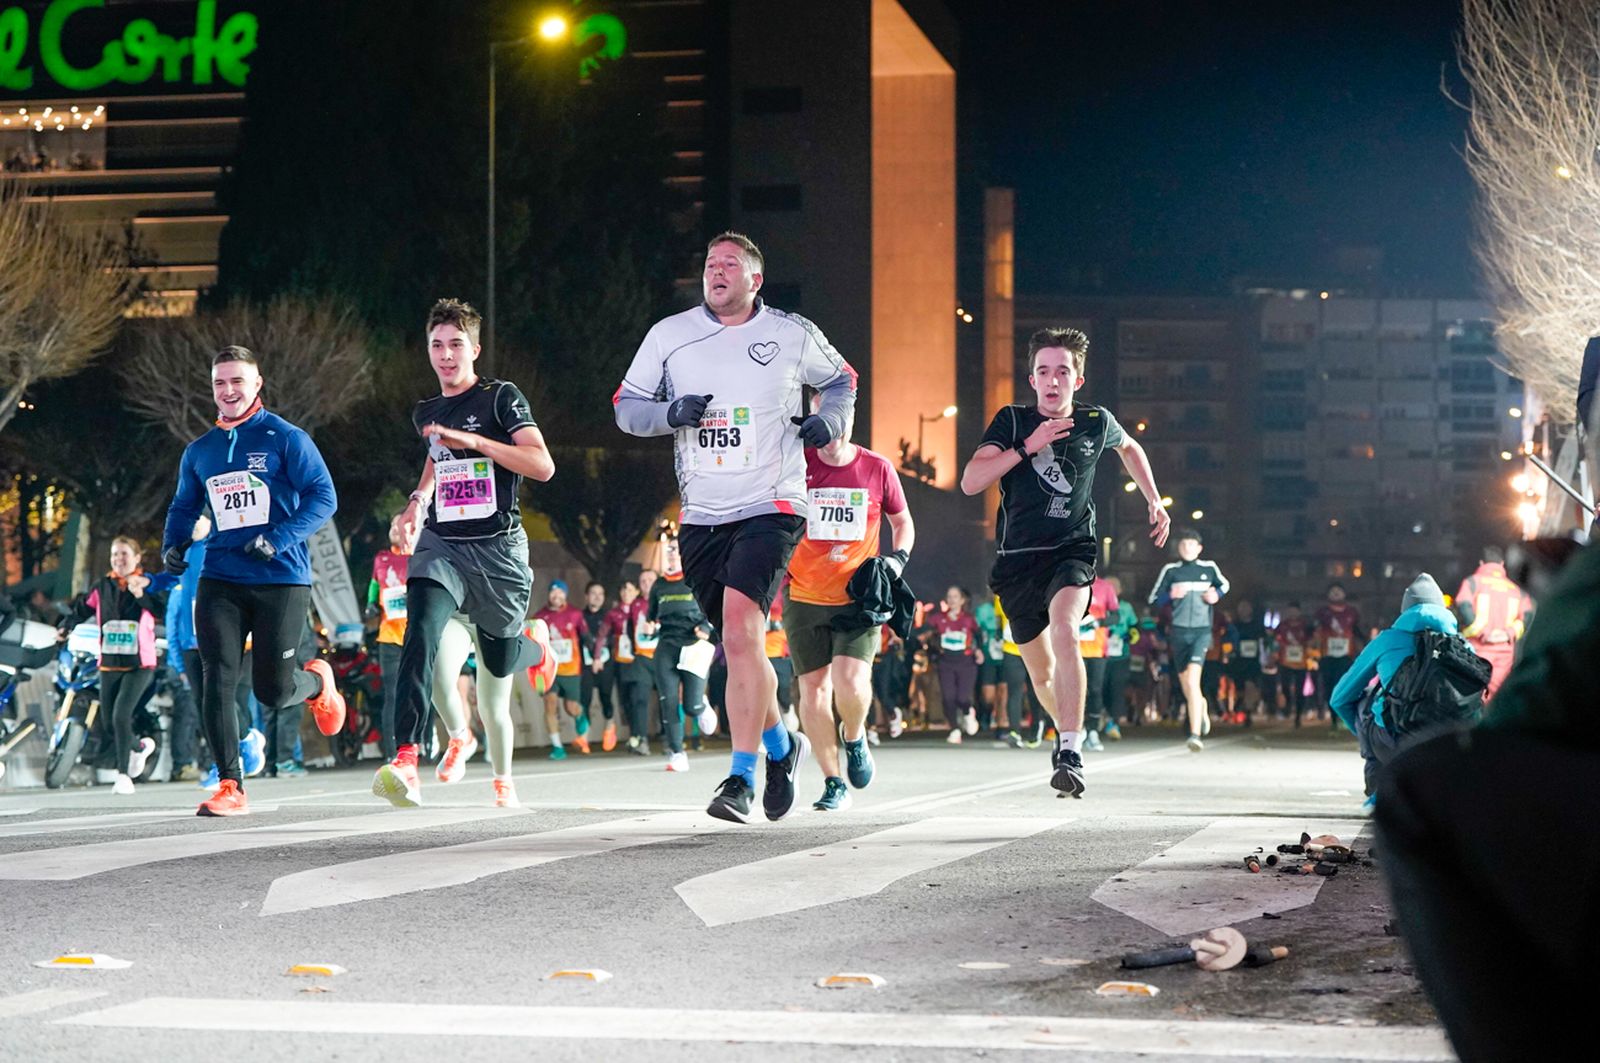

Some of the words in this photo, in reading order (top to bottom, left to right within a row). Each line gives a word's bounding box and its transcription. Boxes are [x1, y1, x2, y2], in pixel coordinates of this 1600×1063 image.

[39, 0, 259, 90] Corte
[702, 410, 717, 418] OCHE
[718, 410, 727, 418] DE
[698, 427, 741, 448] 6753
[1043, 465, 1060, 483] 43
[215, 486, 227, 494] SAN
[441, 479, 488, 501] 5259
[223, 489, 256, 511] 2871
[820, 506, 854, 523] 7705
